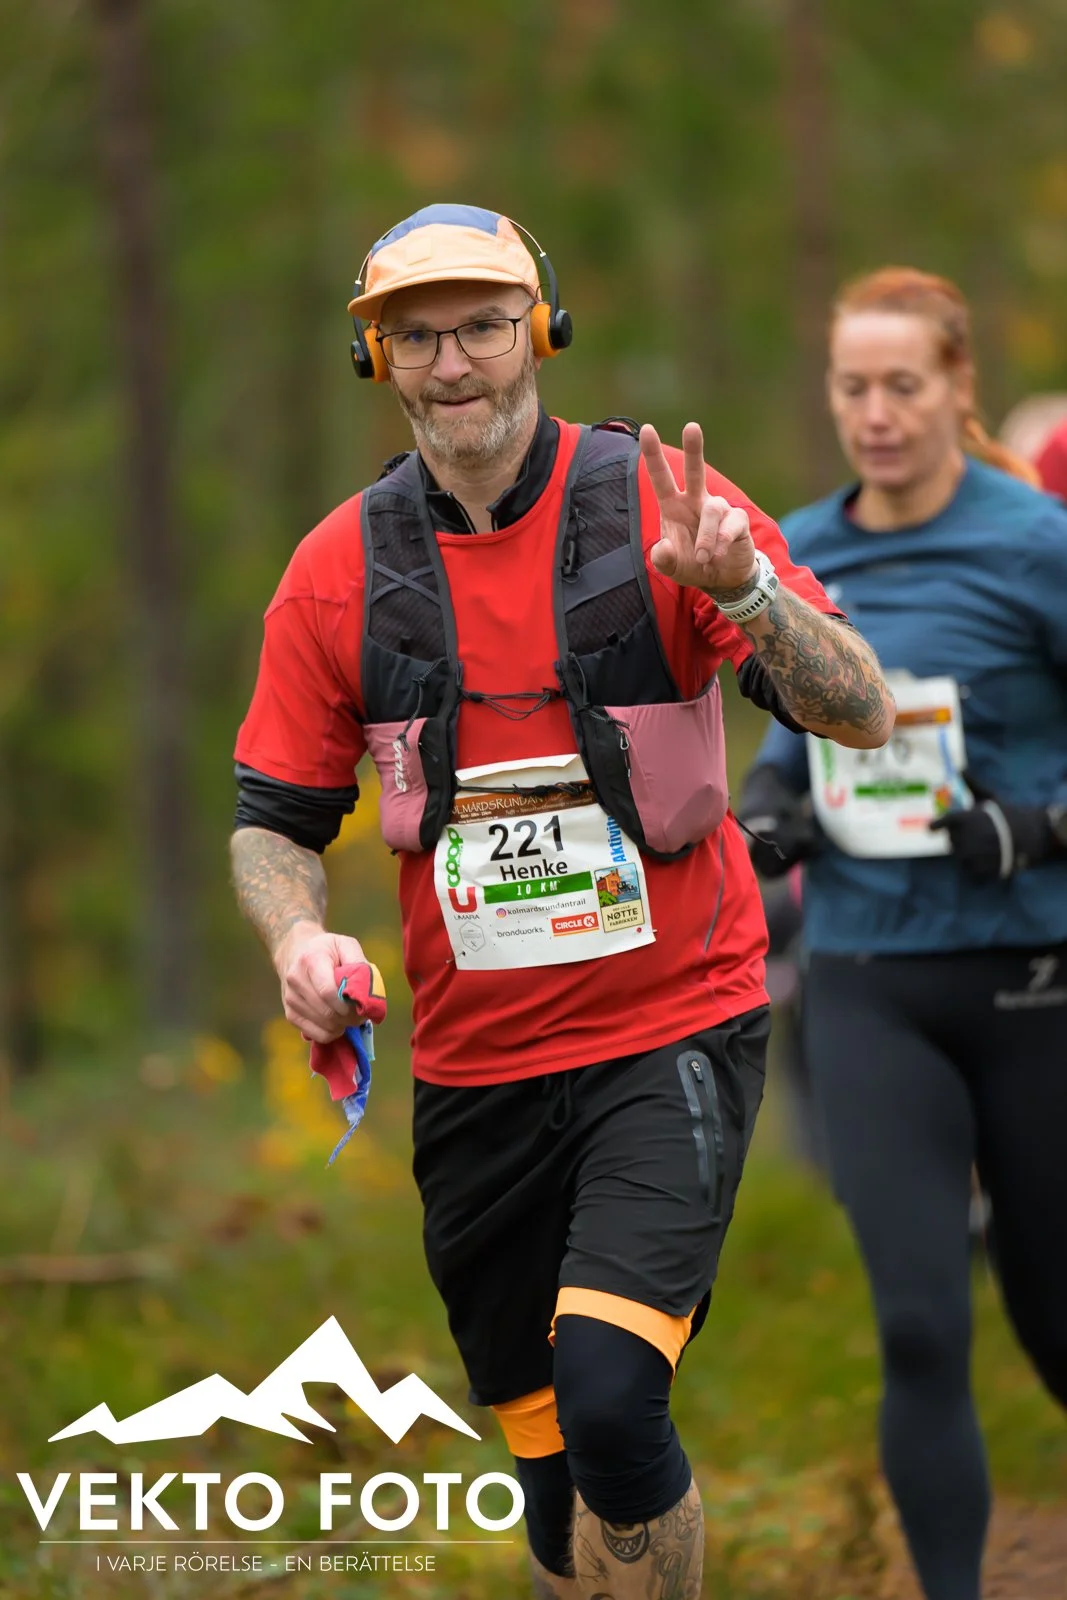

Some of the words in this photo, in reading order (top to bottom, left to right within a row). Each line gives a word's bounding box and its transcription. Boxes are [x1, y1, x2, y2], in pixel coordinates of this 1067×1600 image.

[392, 740, 407, 792] SILVA
[488, 815, 565, 862] 221
[446, 827, 463, 888] coop
[500, 860, 568, 881] Henke
[517, 886, 532, 896] 10
[541, 883, 559, 893] KM
[555, 919, 583, 930] CIRCLE
[583, 915, 595, 928] K
[607, 908, 638, 921] NØTTE
